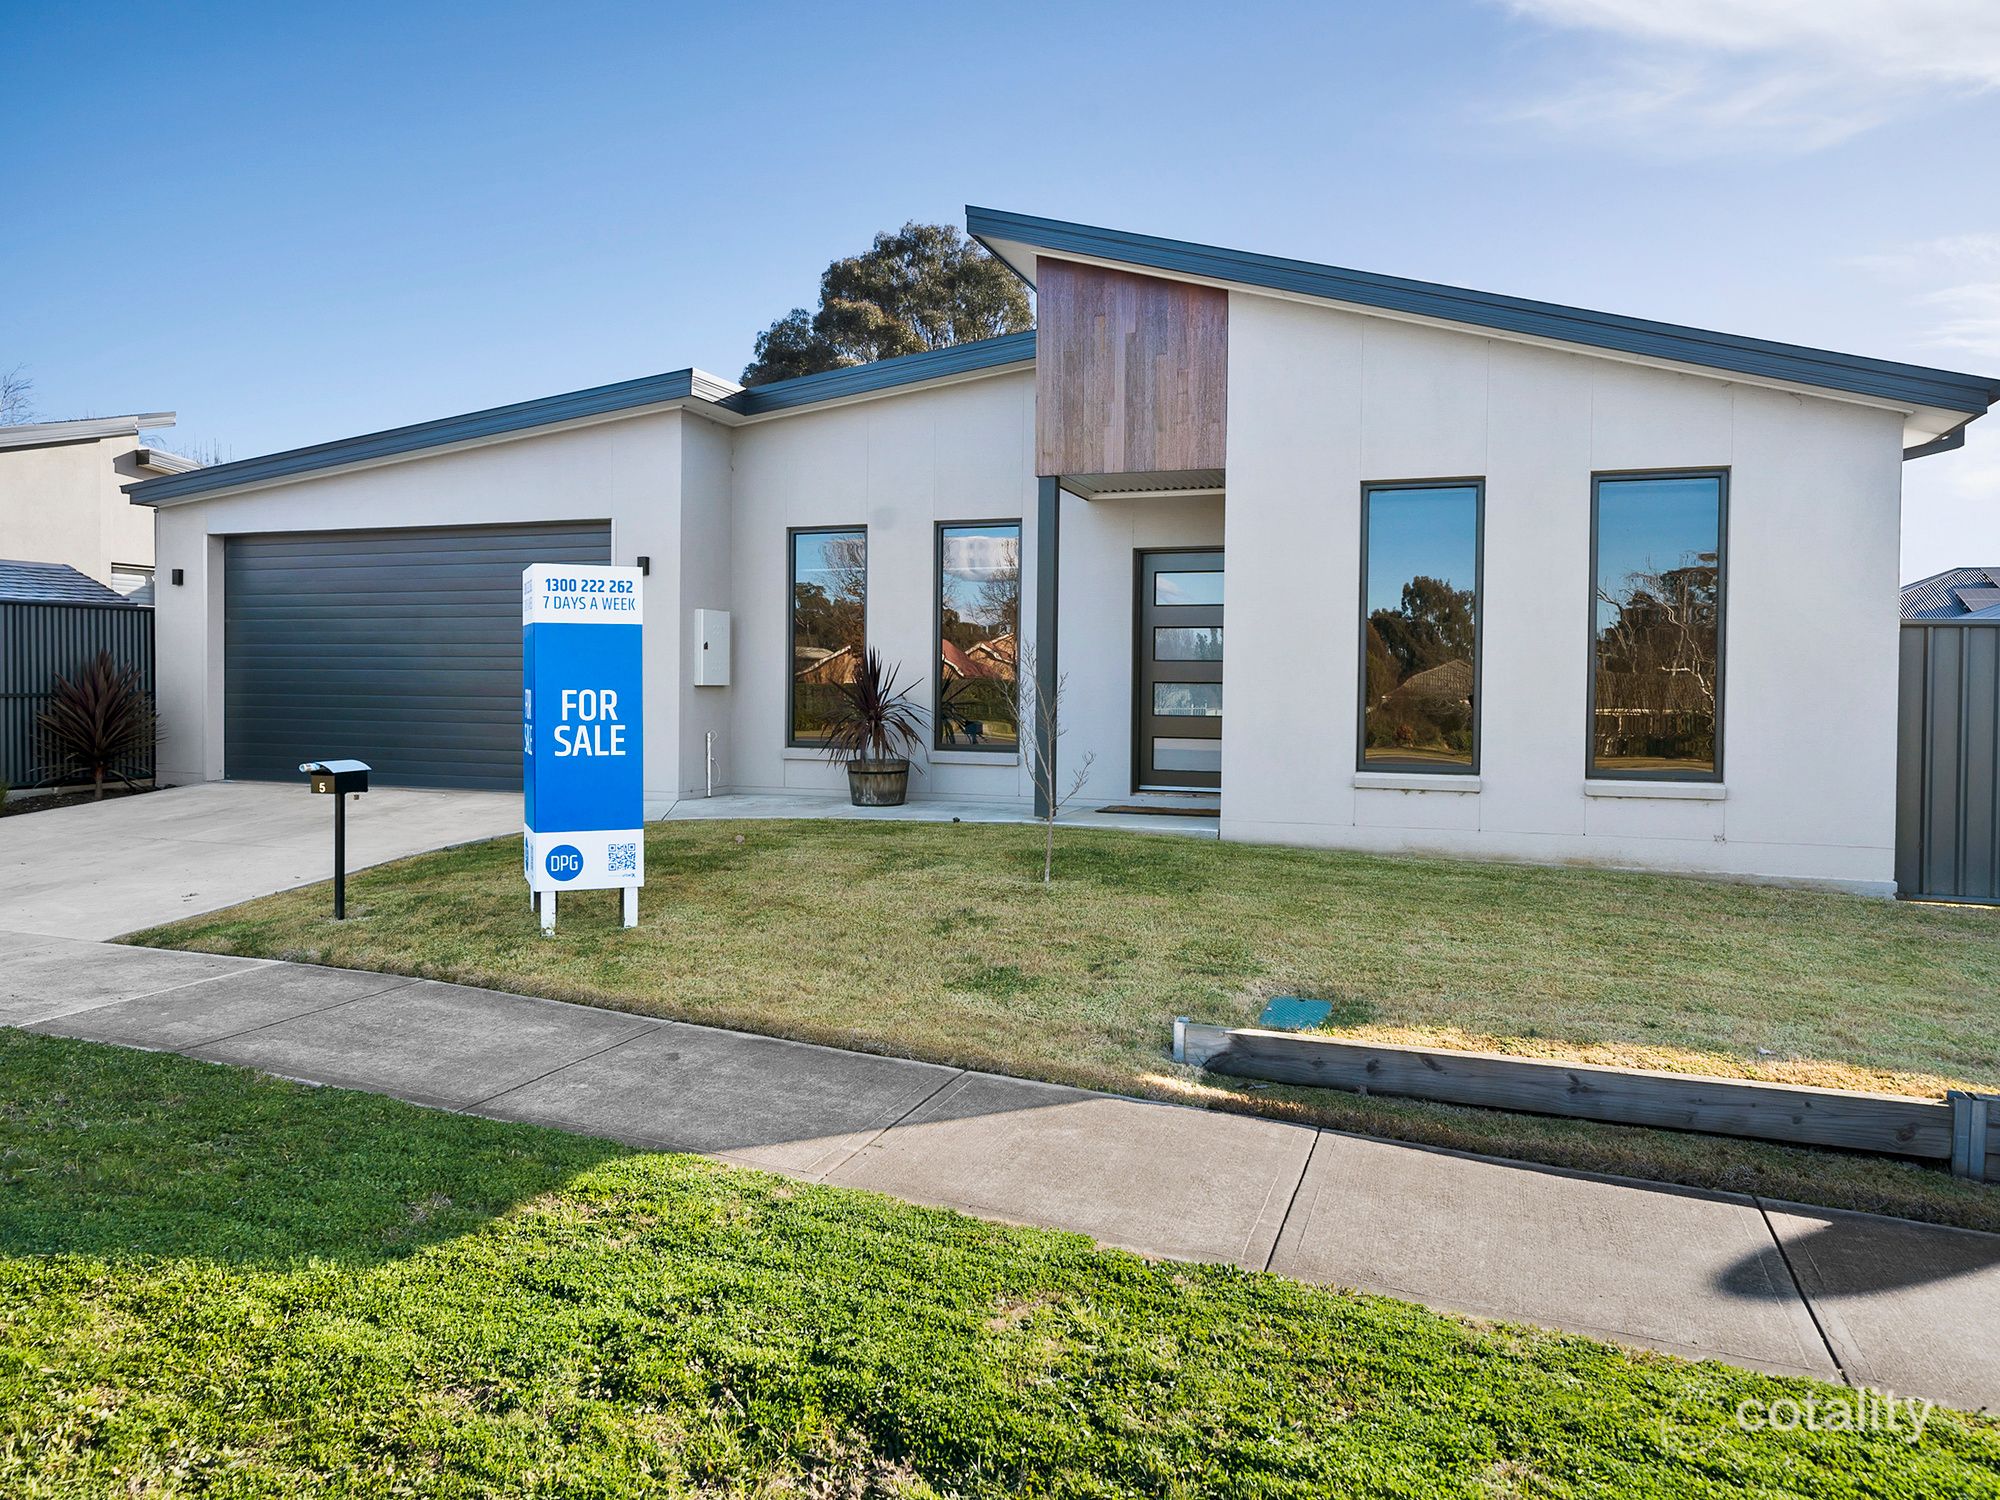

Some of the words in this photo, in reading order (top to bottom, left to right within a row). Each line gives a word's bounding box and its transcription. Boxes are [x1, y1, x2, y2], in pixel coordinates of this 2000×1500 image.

[545, 578, 577, 592] 1300
[581, 579, 605, 593] 222
[609, 580, 633, 593] 262
[543, 596, 550, 609] 7
[553, 596, 586, 610] DAYS
[589, 597, 598, 610] A
[602, 597, 636, 611] WEEK
[561, 689, 618, 721] FOR
[553, 724, 626, 757] SALE
[319, 782, 326, 793] 5
[550, 855, 579, 872] DPG
